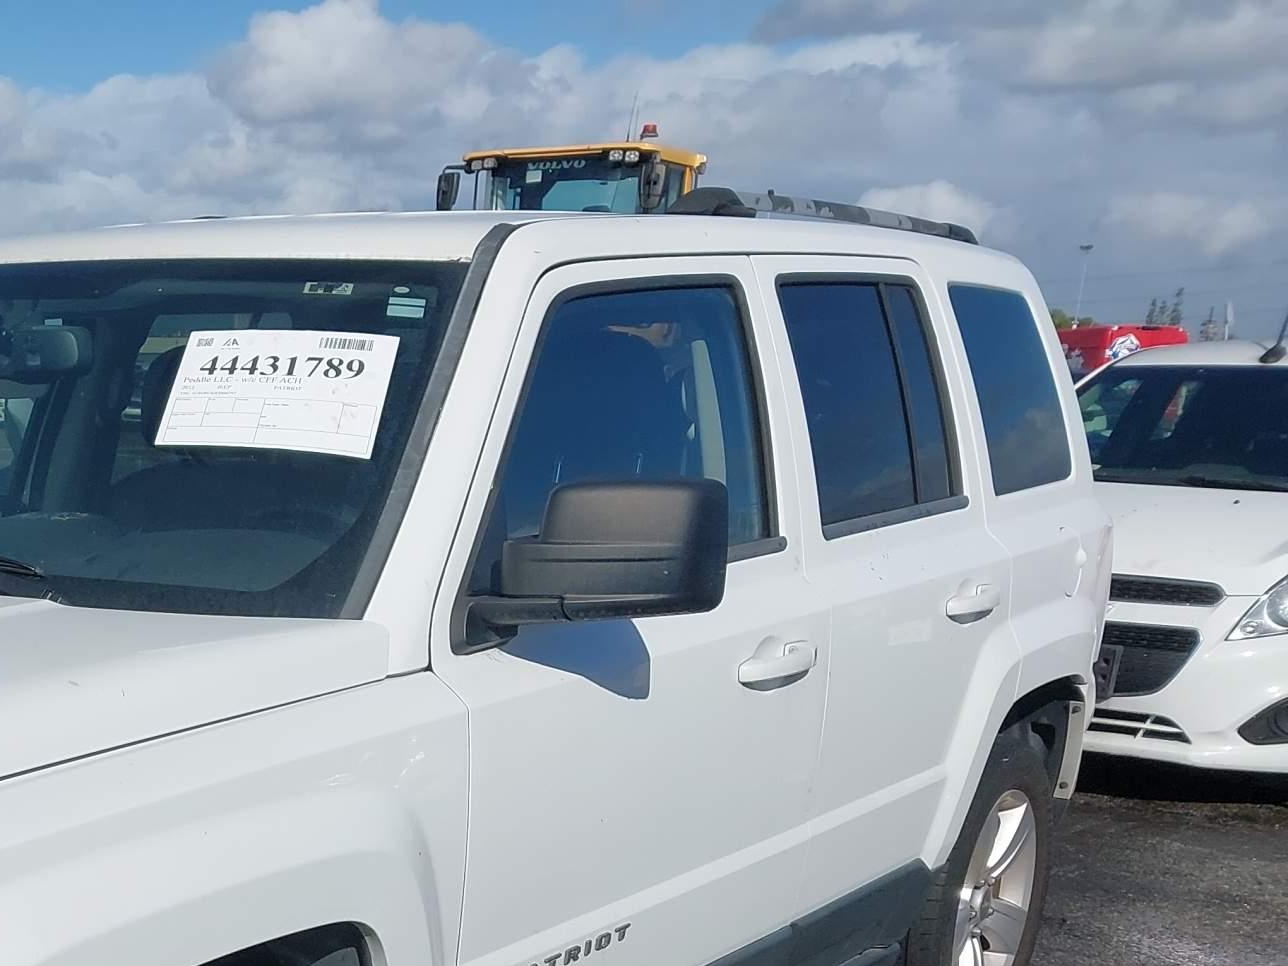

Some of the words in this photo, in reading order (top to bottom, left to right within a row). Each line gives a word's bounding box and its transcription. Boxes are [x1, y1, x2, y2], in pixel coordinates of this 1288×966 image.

[527, 159, 586, 170] VOLVO
[199, 354, 366, 380] 44431789
[213, 375, 233, 383] LLC
